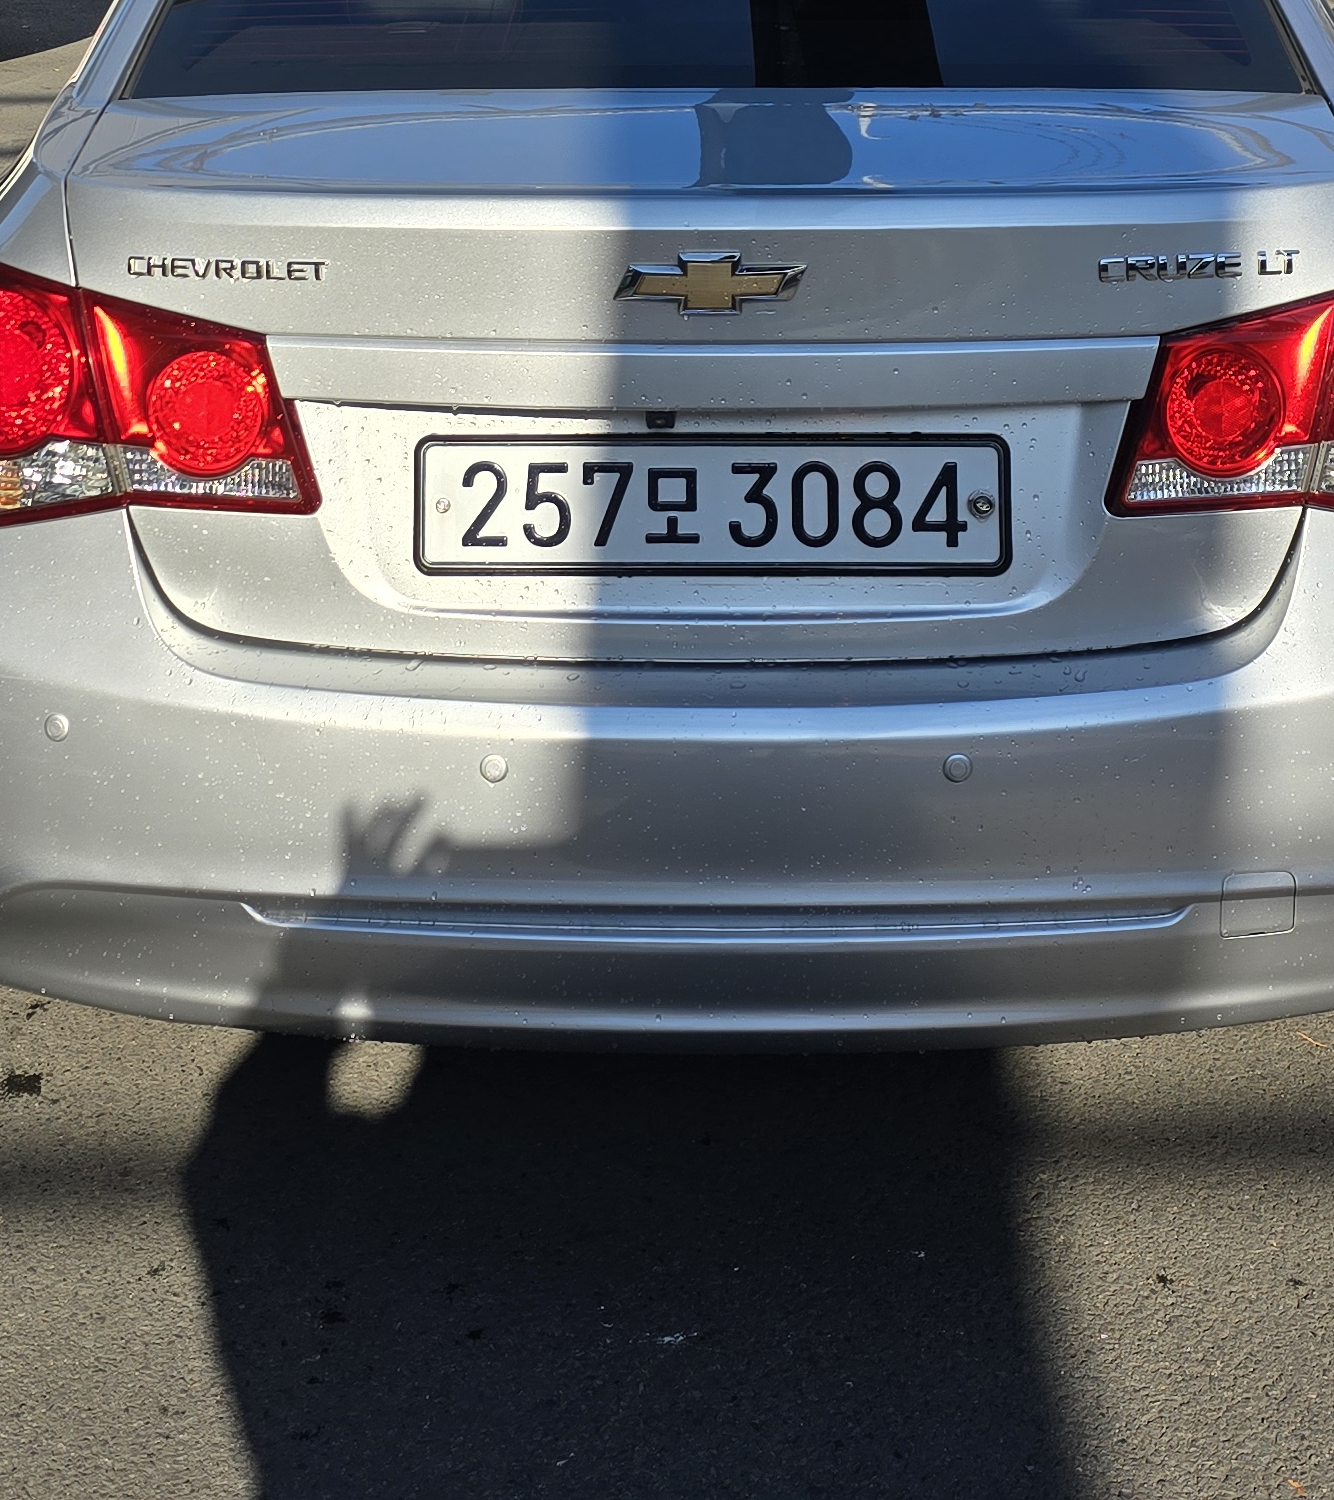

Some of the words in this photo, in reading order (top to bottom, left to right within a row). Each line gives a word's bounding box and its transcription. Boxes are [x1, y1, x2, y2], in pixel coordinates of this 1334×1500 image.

[127, 255, 331, 282] CHEVROLET
[1098, 251, 1243, 284] CRUZE
[1257, 249, 1301, 276] LT
